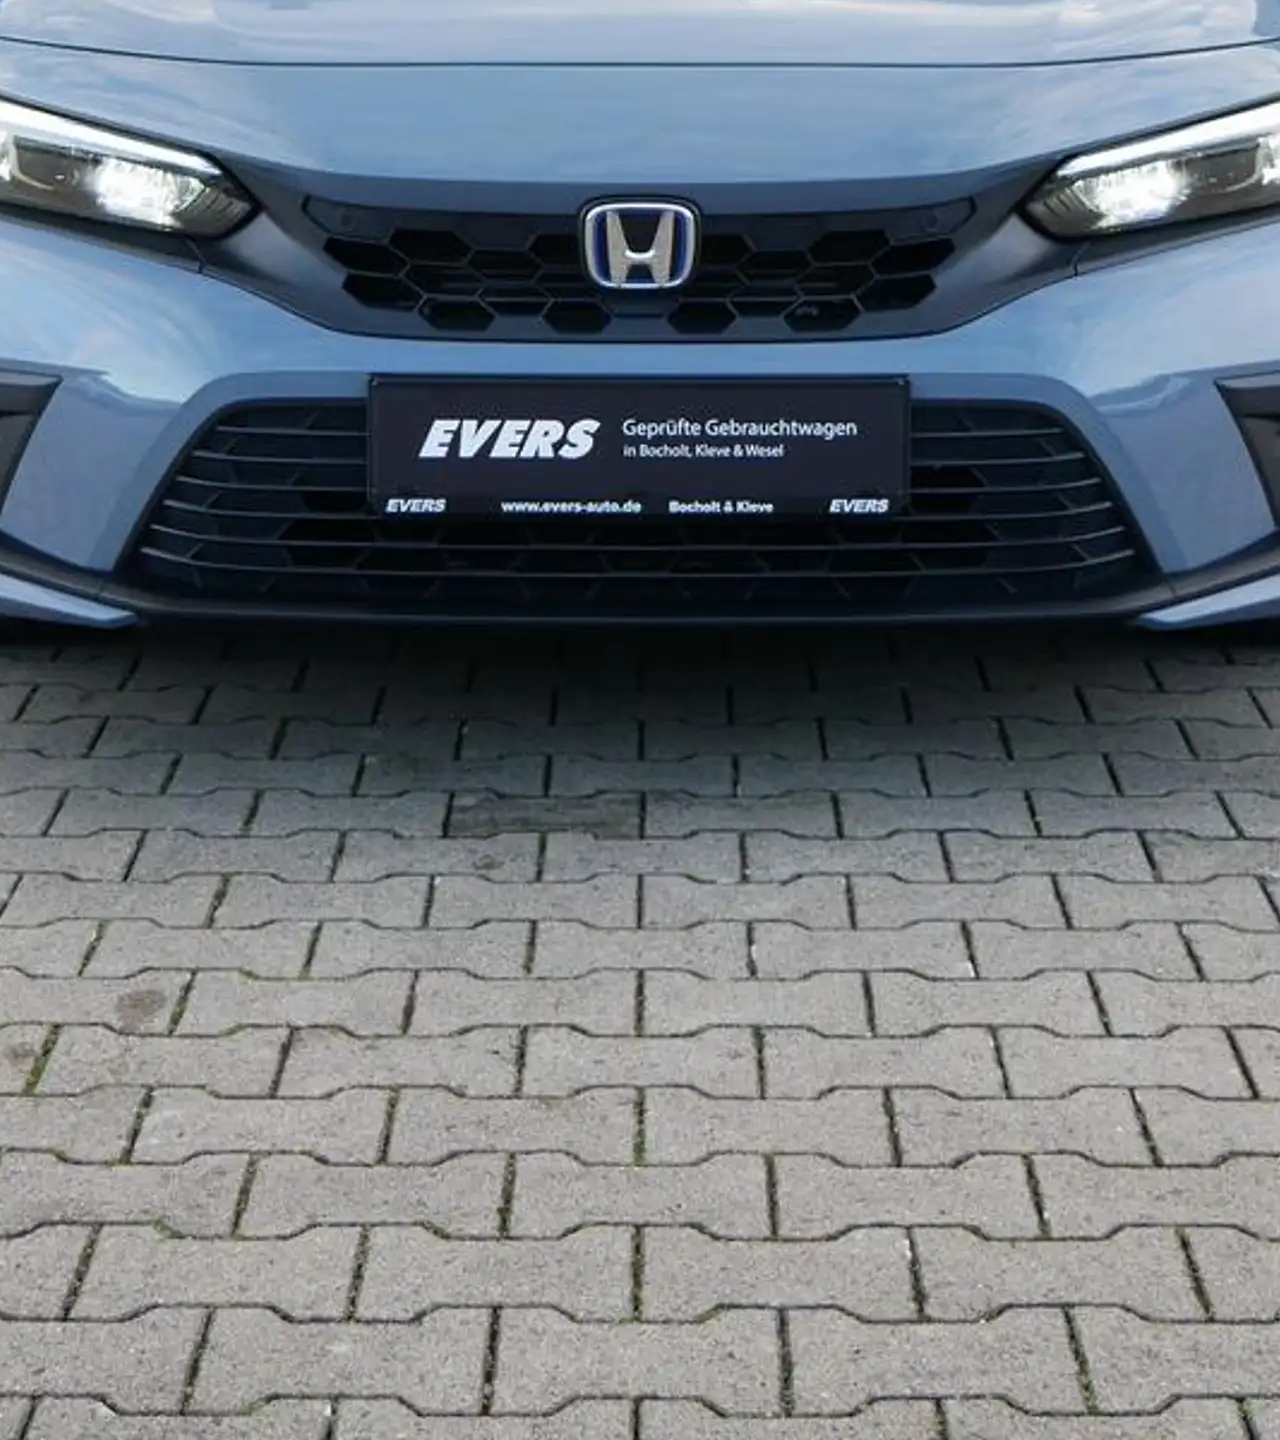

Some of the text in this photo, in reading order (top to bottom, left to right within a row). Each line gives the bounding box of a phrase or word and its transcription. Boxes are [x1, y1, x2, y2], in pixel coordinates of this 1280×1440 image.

[622, 418, 858, 440] Geprüfte Gebrauchtwagen
[419, 418, 601, 459] EVERS
[623, 444, 784, 458] in Bocholt, Kleve & Wesel
[386, 499, 447, 512] EVERS
[501, 500, 642, 512] www.evers-auto.de
[668, 500, 773, 513] Bocholt & Kleve
[829, 499, 889, 512] EVERS
